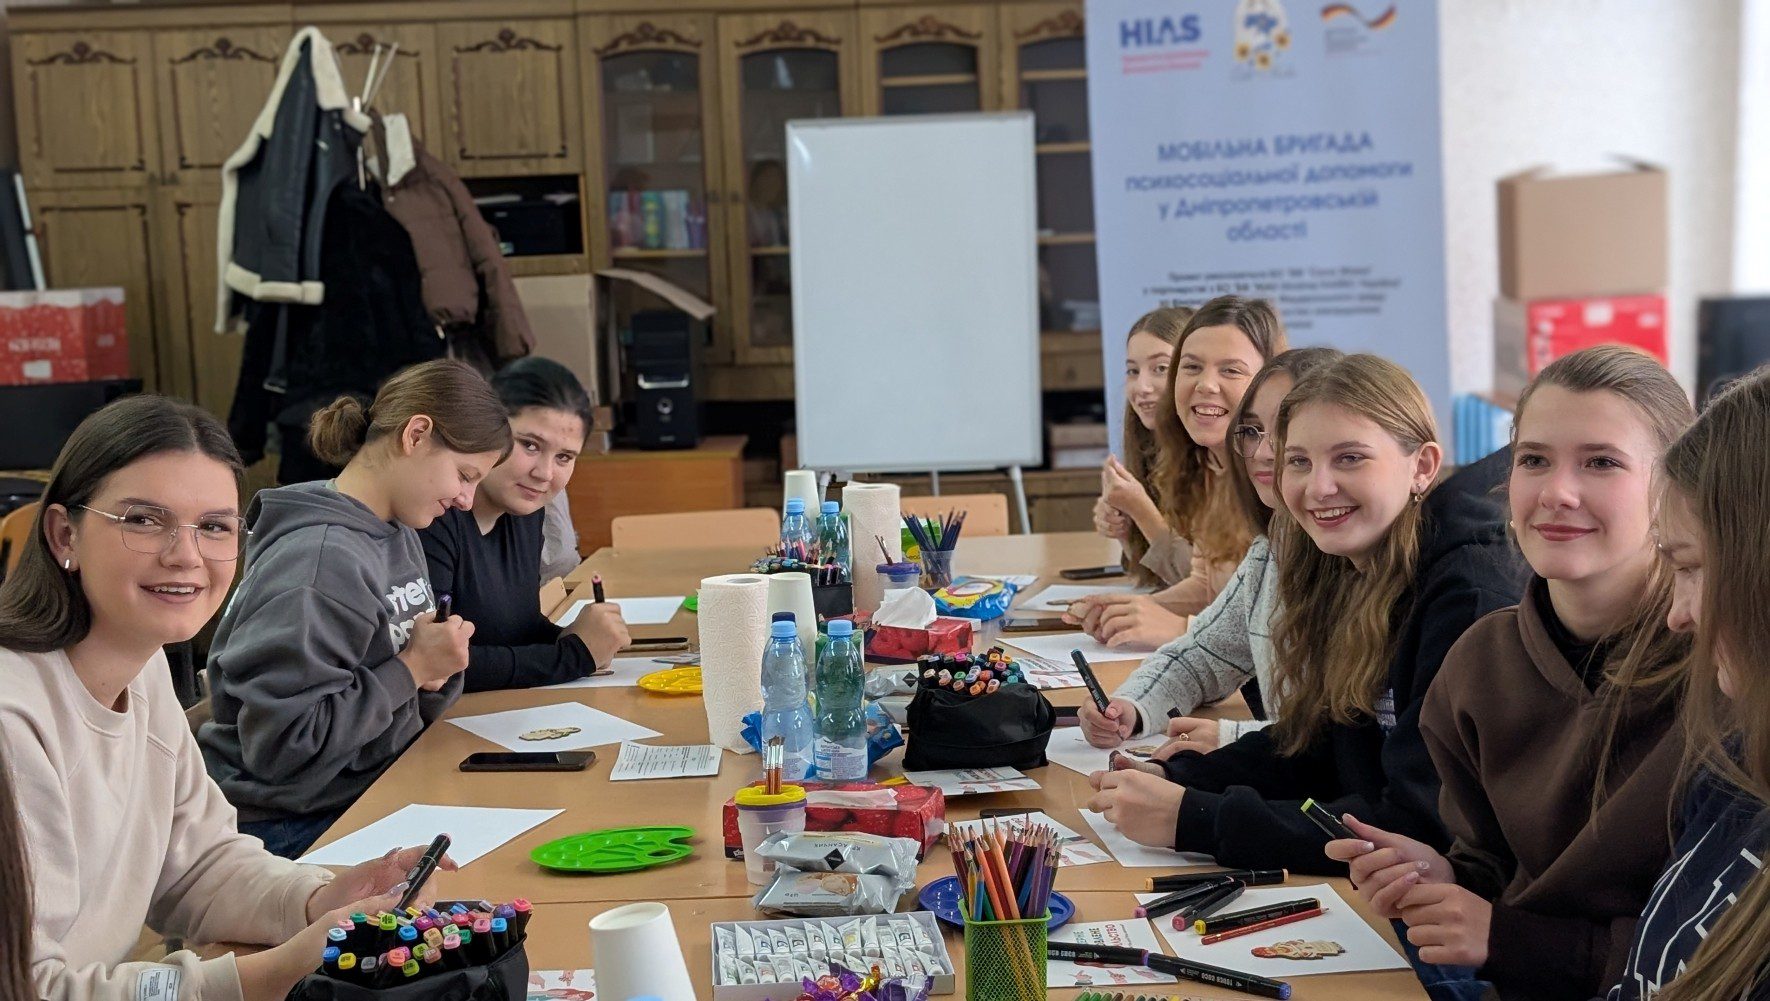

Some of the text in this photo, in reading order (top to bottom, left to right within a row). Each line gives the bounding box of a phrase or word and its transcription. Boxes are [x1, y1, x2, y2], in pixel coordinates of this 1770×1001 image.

[1119, 13, 1201, 49] HIAS
[1158, 131, 1373, 162] МОБІЛЬНА БРИГАДА
[1304, 161, 1413, 184] допомоги
[1226, 220, 1308, 242] області
